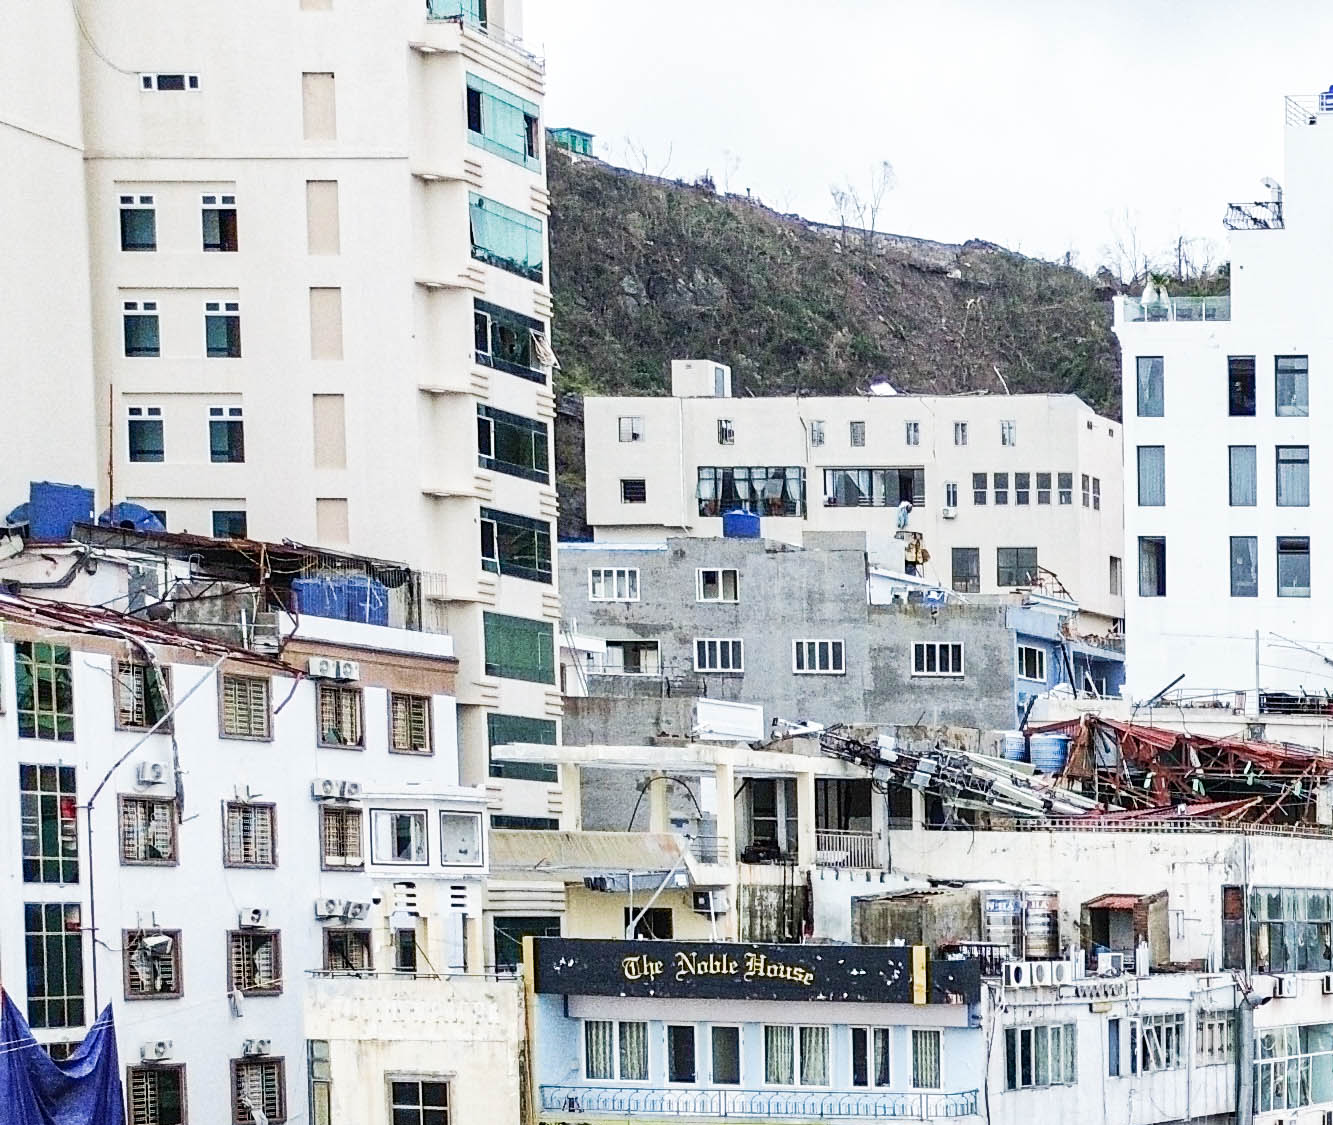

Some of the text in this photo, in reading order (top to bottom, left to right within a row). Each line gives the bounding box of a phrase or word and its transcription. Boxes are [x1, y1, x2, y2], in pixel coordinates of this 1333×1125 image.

[622, 951, 814, 985] The Noble House
